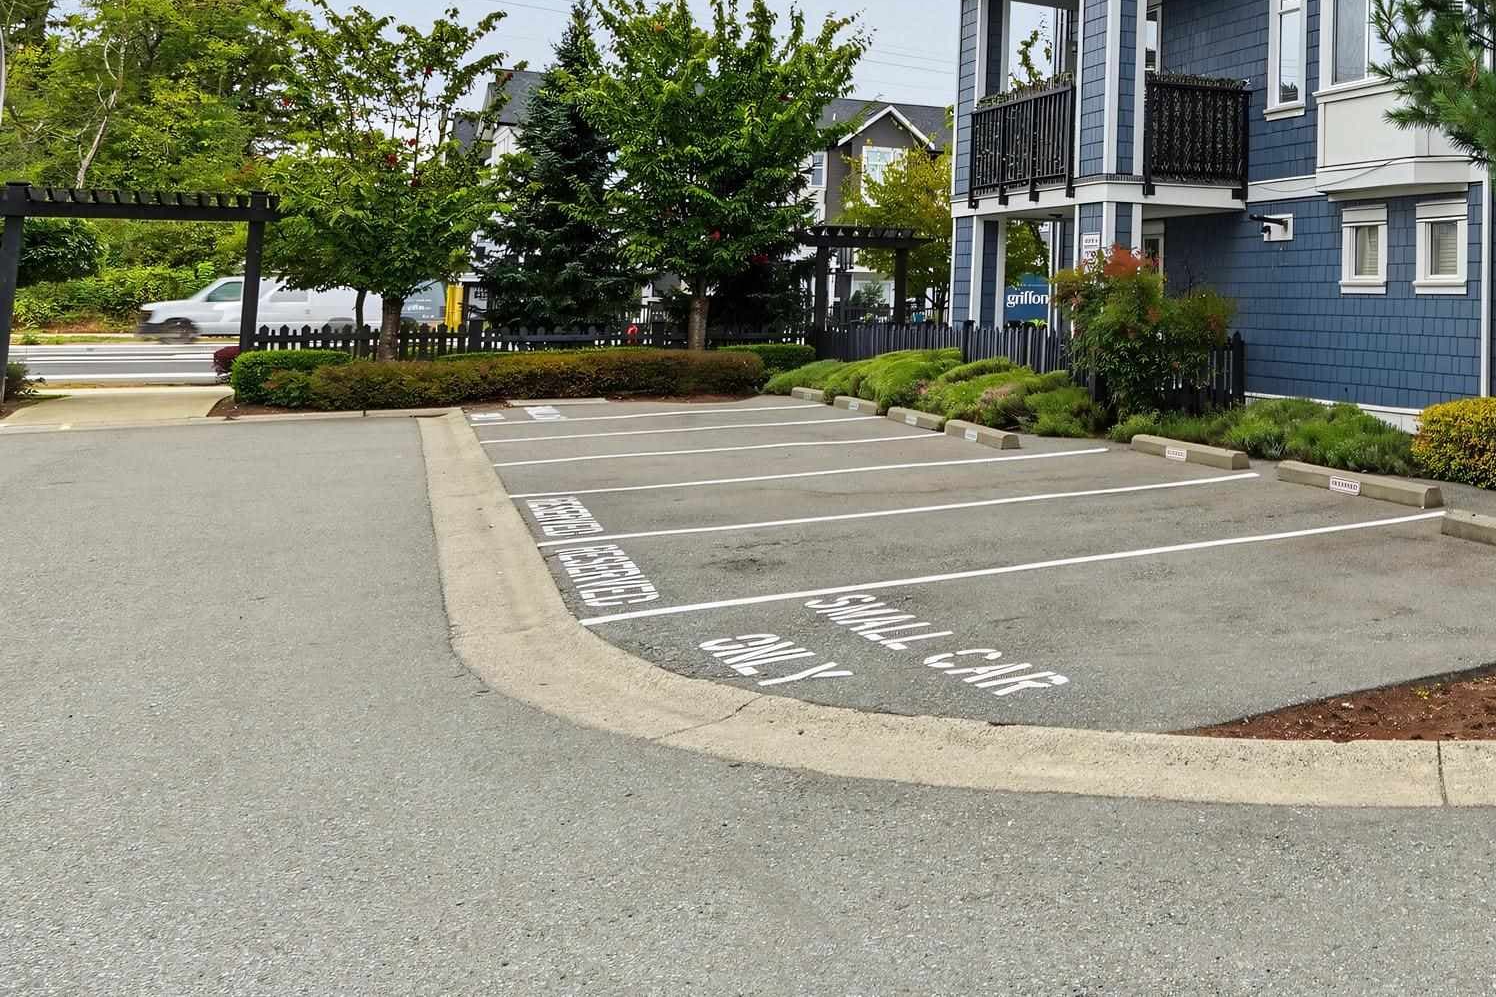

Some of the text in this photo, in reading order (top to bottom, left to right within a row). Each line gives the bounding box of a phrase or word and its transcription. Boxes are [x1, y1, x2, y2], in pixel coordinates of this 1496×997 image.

[1006, 290, 1048, 307] griffon
[554, 544, 660, 607] RESERVED
[699, 633, 854, 686] ONLY
[805, 594, 1069, 695] SMALL CAR
